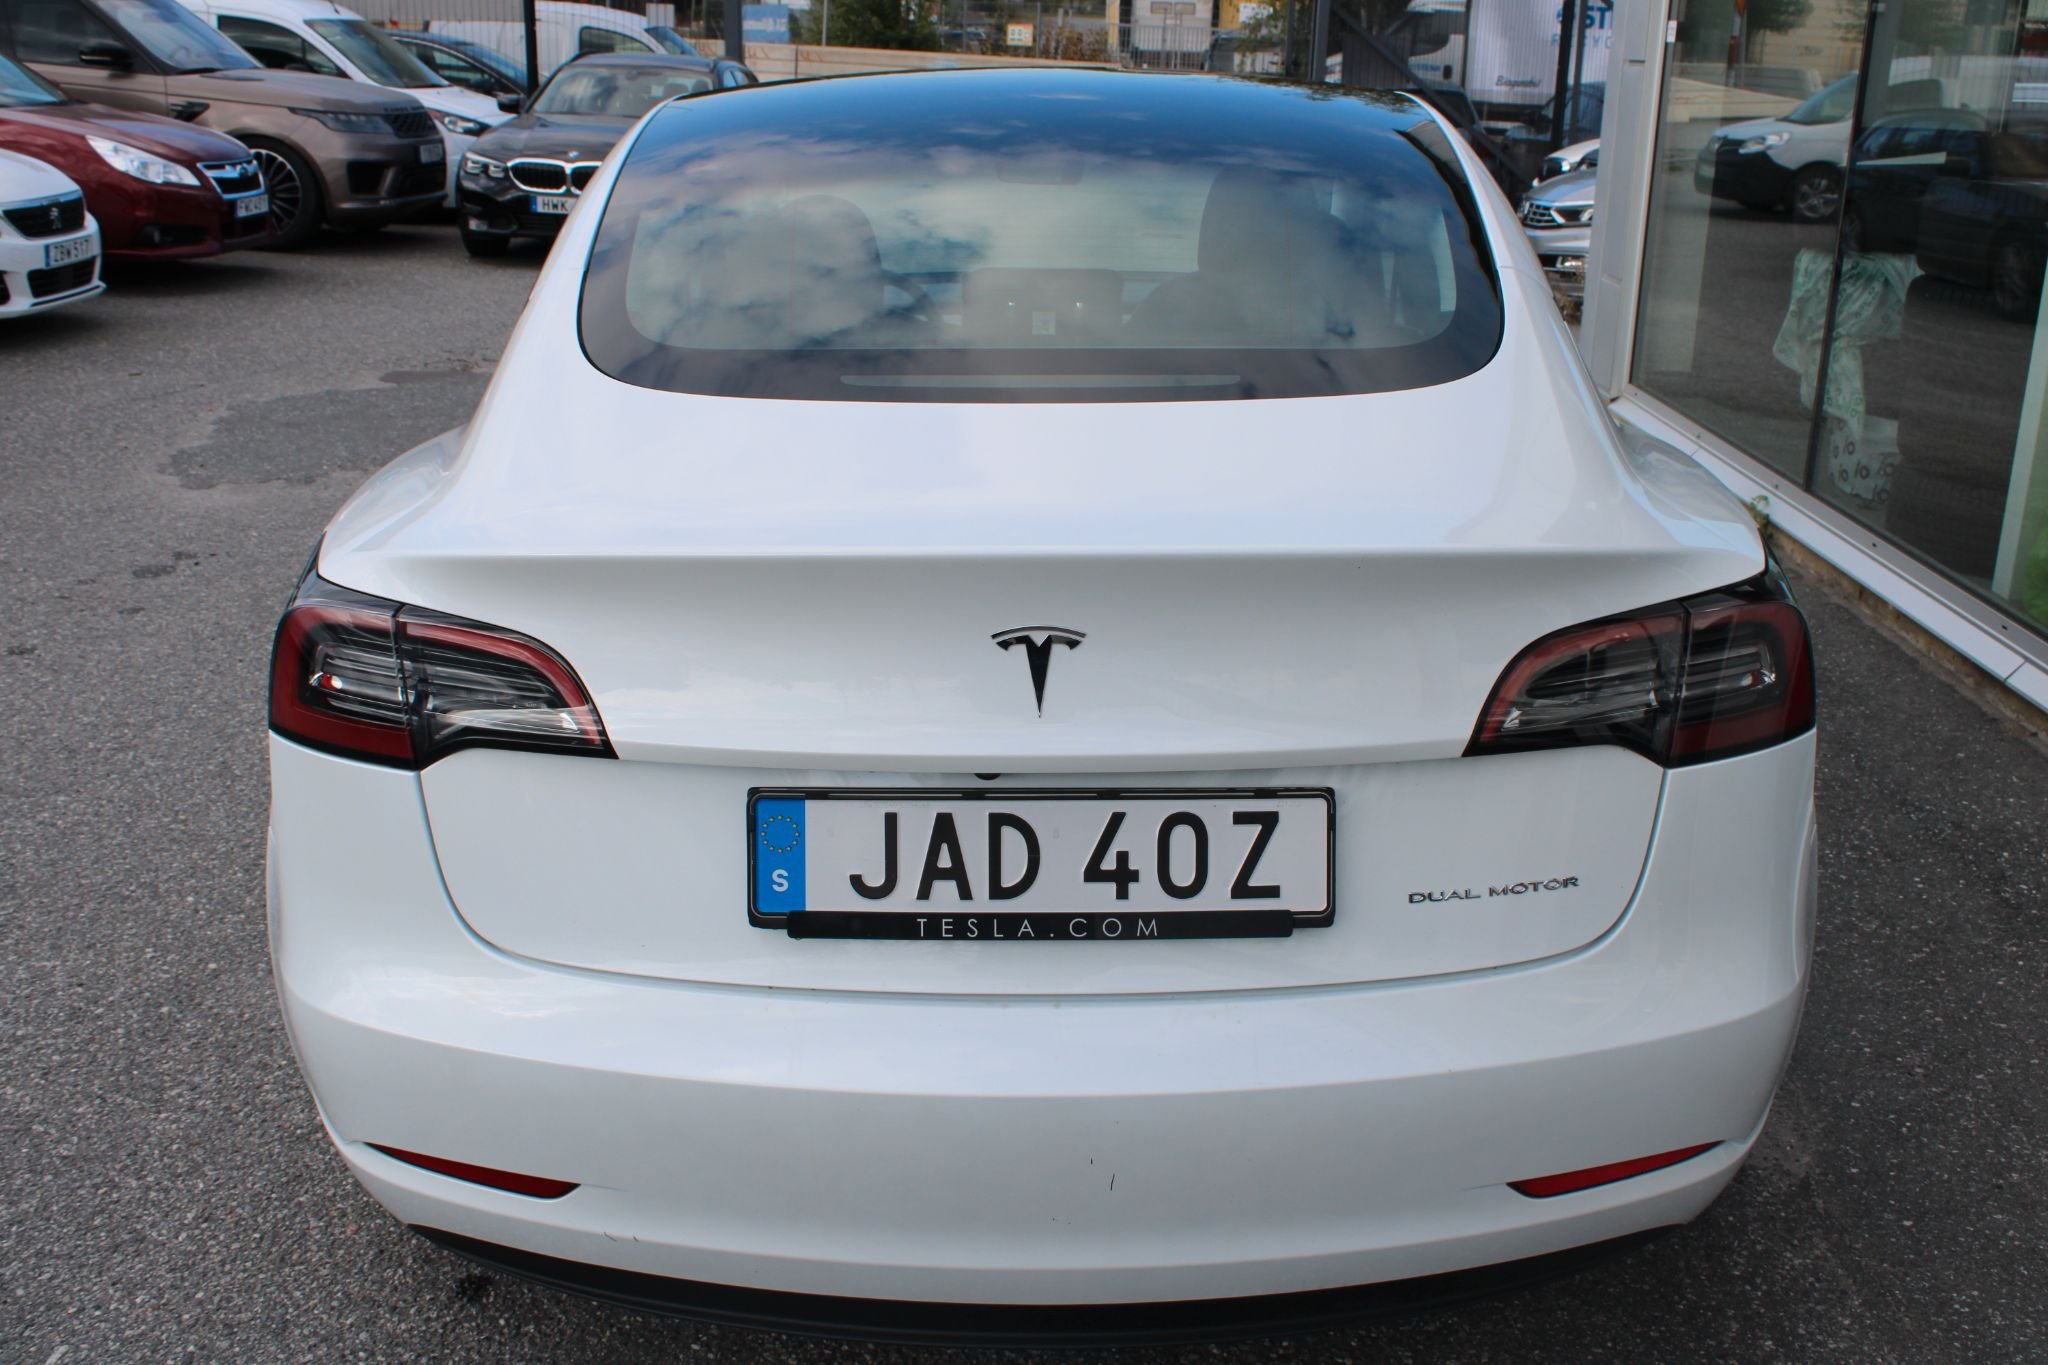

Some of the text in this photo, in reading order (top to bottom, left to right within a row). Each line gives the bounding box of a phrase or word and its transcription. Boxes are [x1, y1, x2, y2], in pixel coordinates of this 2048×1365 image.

[542, 199, 568, 212] HWK
[54, 239, 89, 262] ZBW 517
[771, 811, 1281, 900] S JAD 40Z
[1408, 876, 1579, 904] DUAL MOTOR
[916, 918, 1158, 938] TESLA.COM
